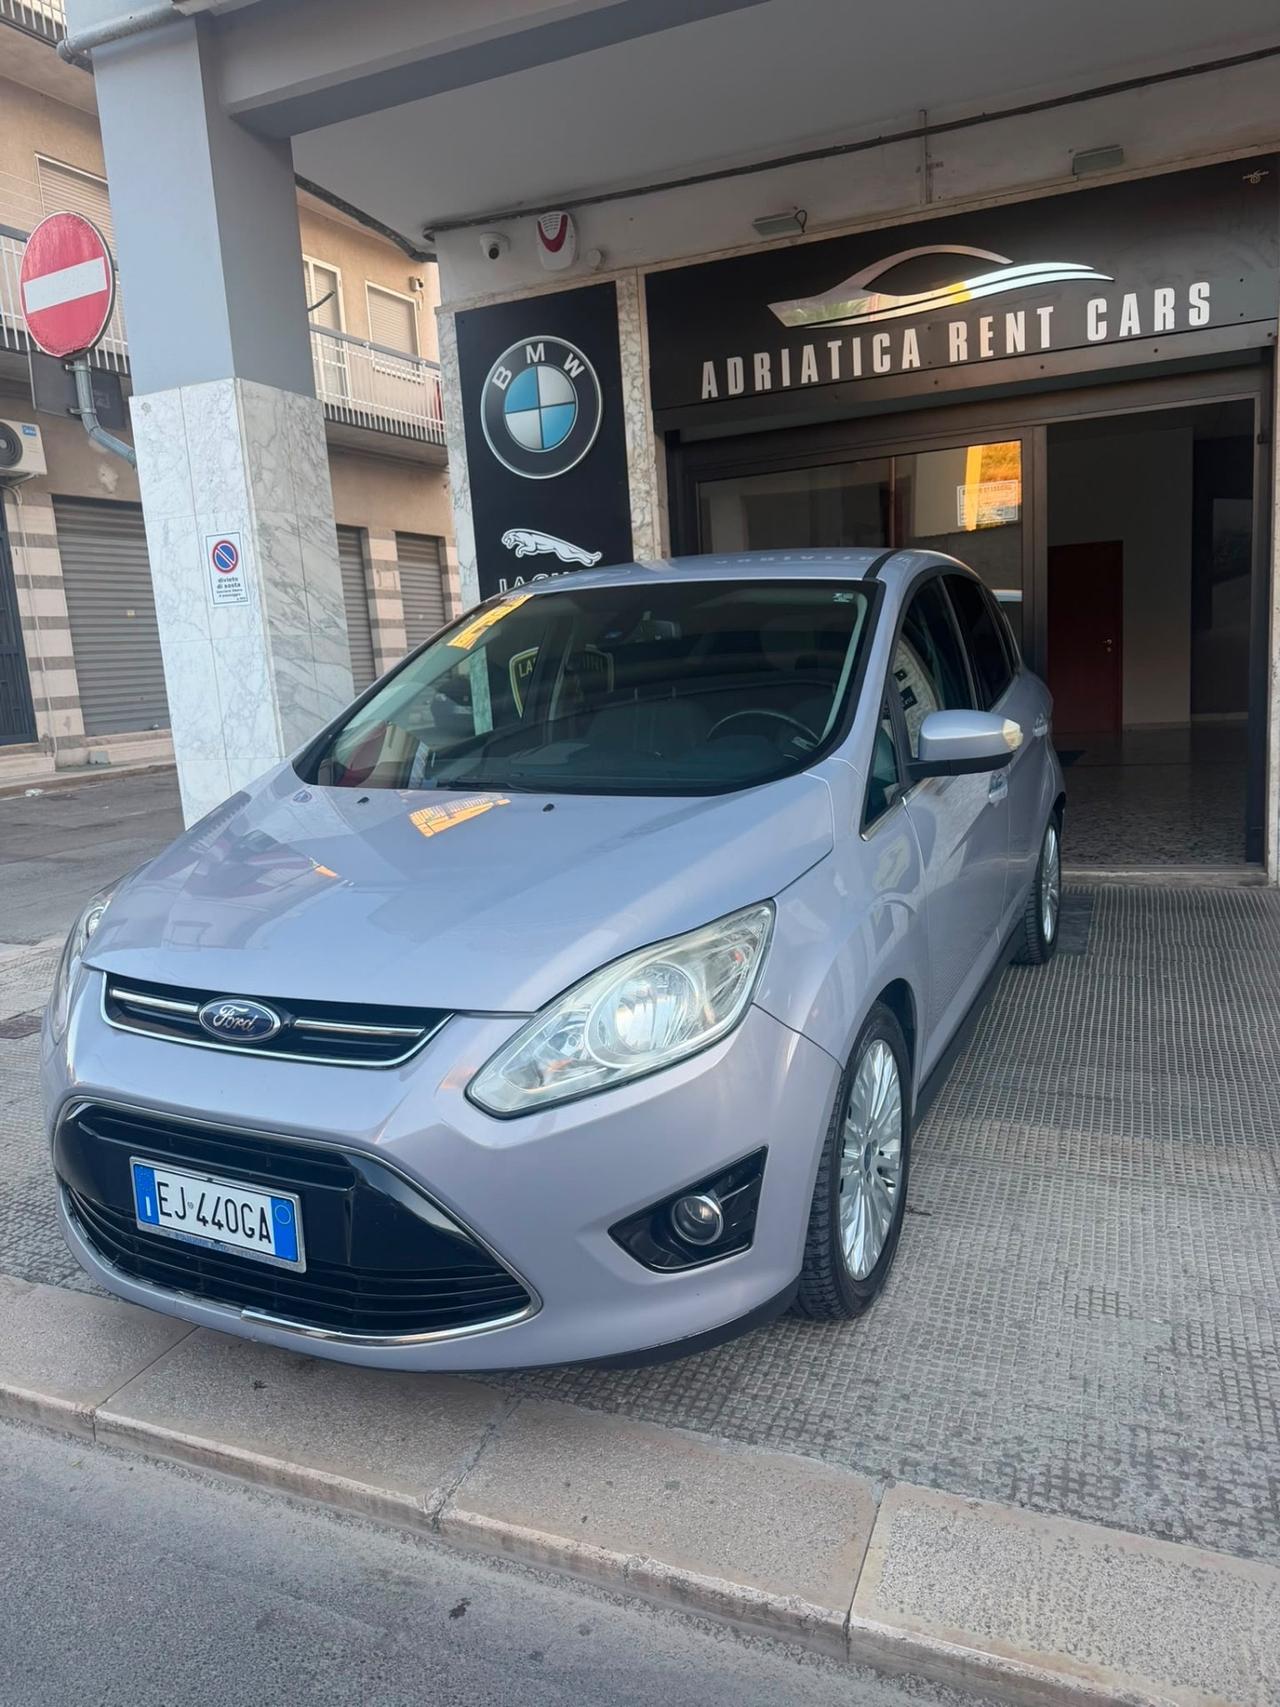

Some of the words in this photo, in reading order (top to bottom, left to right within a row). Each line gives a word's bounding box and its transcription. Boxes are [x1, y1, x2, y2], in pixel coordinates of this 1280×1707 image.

[701, 327, 921, 400] ADRIATICA
[948, 305, 1054, 363] RENT
[1087, 281, 1211, 342] CARS
[491, 342, 585, 391] BMW
[212, 1004, 259, 1032] Ford
[196, 1191, 272, 1244] 440GA
